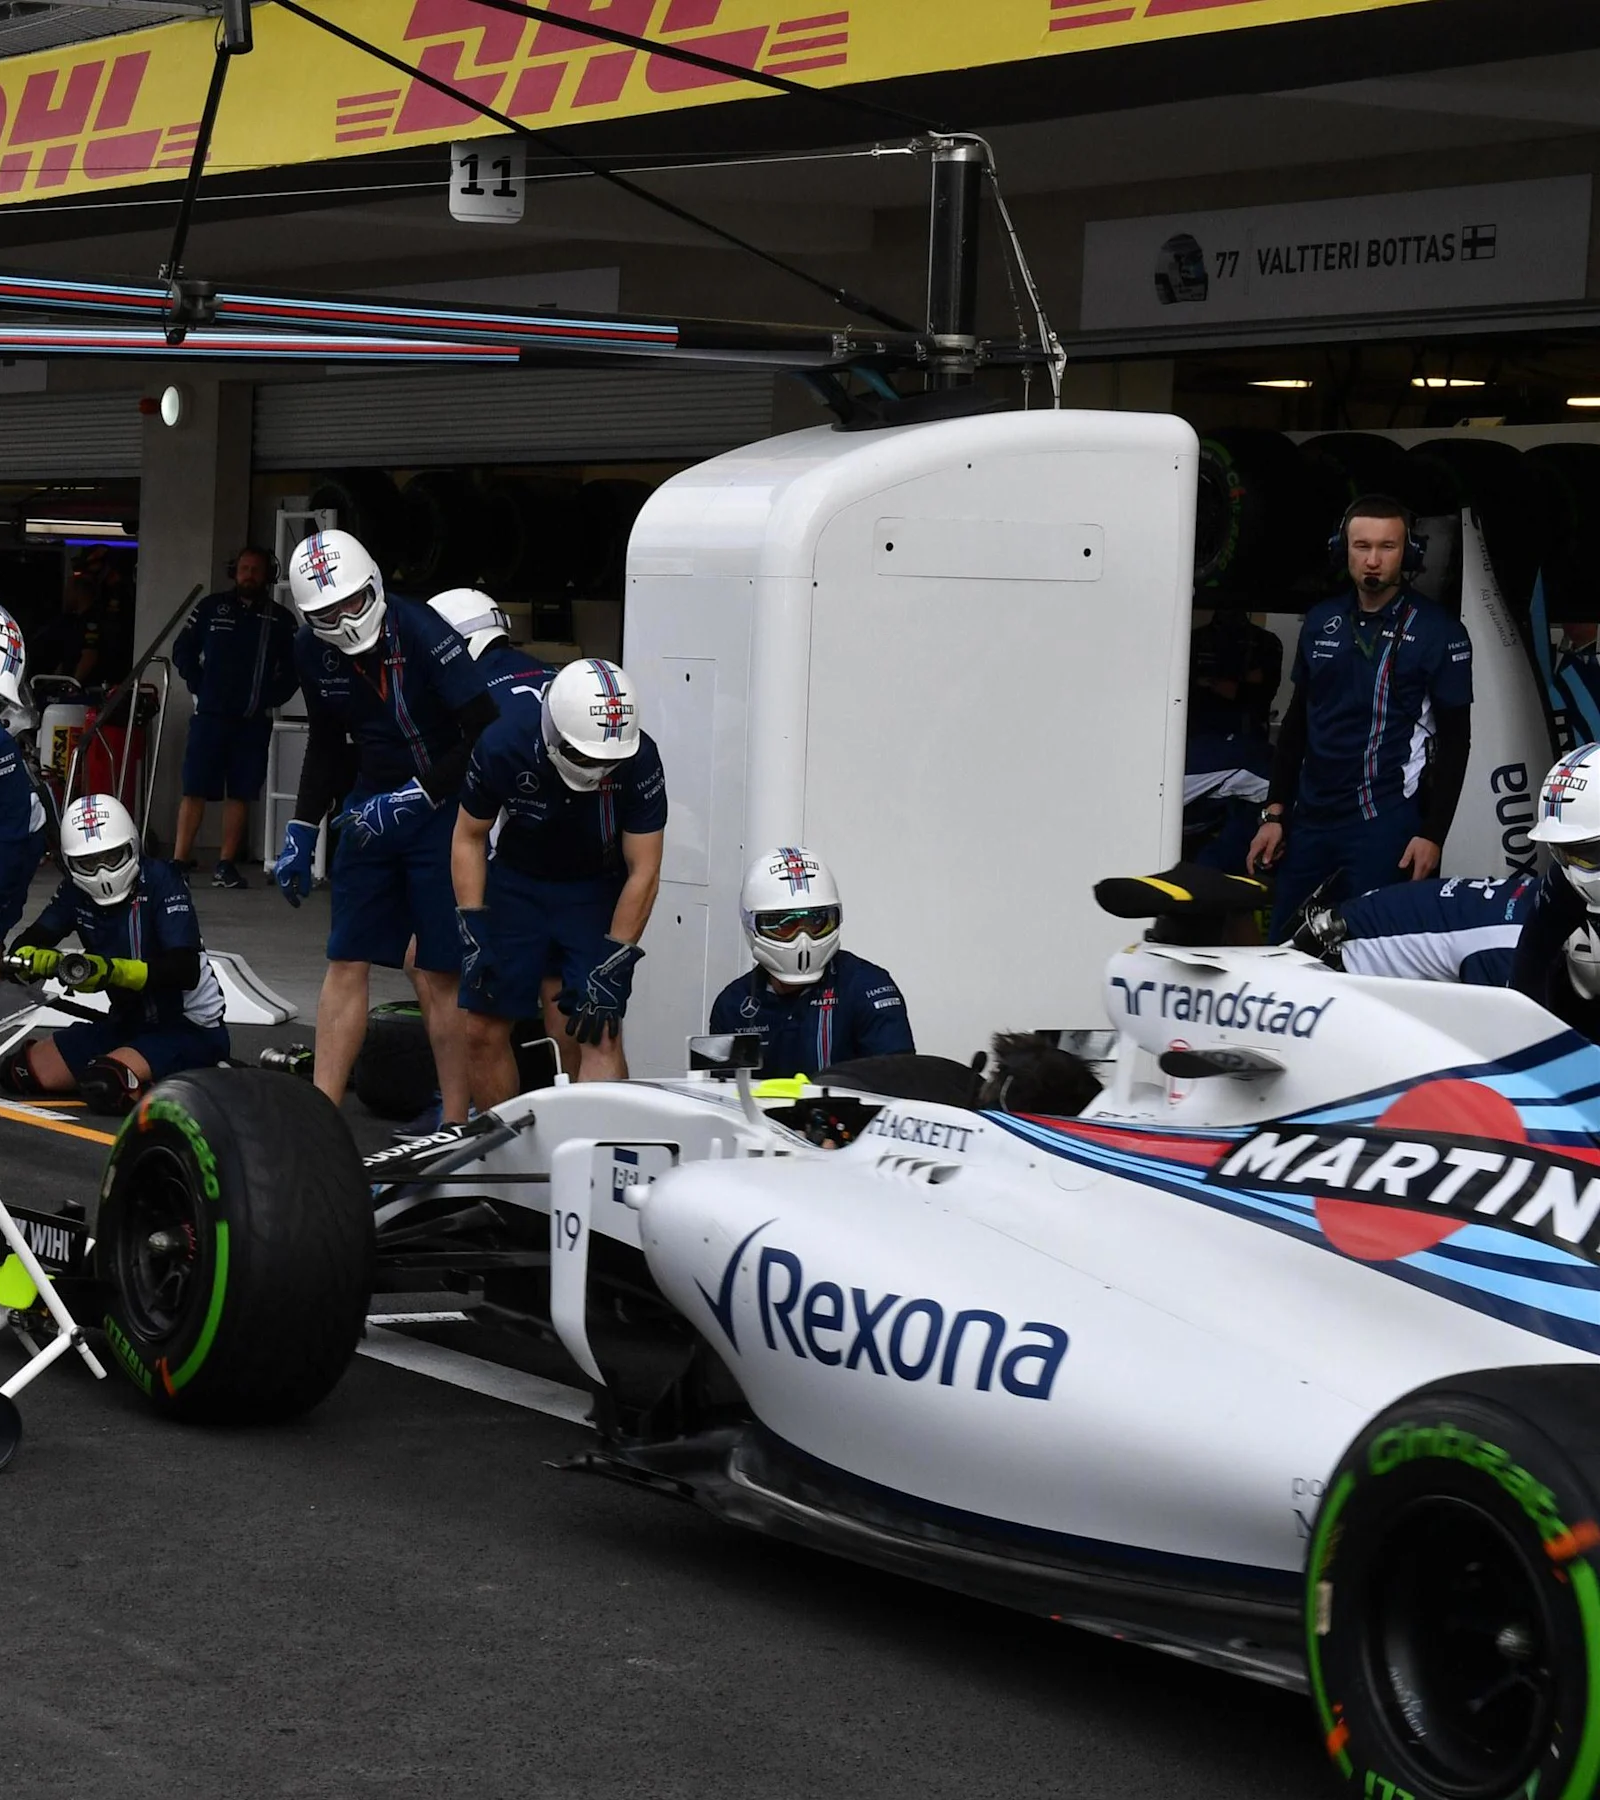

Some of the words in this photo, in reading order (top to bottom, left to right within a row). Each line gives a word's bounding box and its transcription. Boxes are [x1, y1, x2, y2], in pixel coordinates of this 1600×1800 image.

[391, 0, 769, 134] DHL
[460, 153, 517, 197] 11
[1215, 251, 1239, 278] 77
[1257, 241, 1359, 275] VALTTERI
[1367, 233, 1455, 268] BOTTAS
[300, 551, 340, 574] MARTINI
[591, 705, 633, 715] MARTINI
[72, 811, 109, 825] MARTINI
[1490, 762, 1538, 879] xona
[771, 861, 819, 874] MARTINI
[1161, 981, 1335, 1039] randstad
[868, 1109, 973, 1153] HACKETT
[1219, 1132, 1600, 1255] MARTIN
[555, 1209, 581, 1252] 19
[758, 1246, 1069, 1400] Rexona
